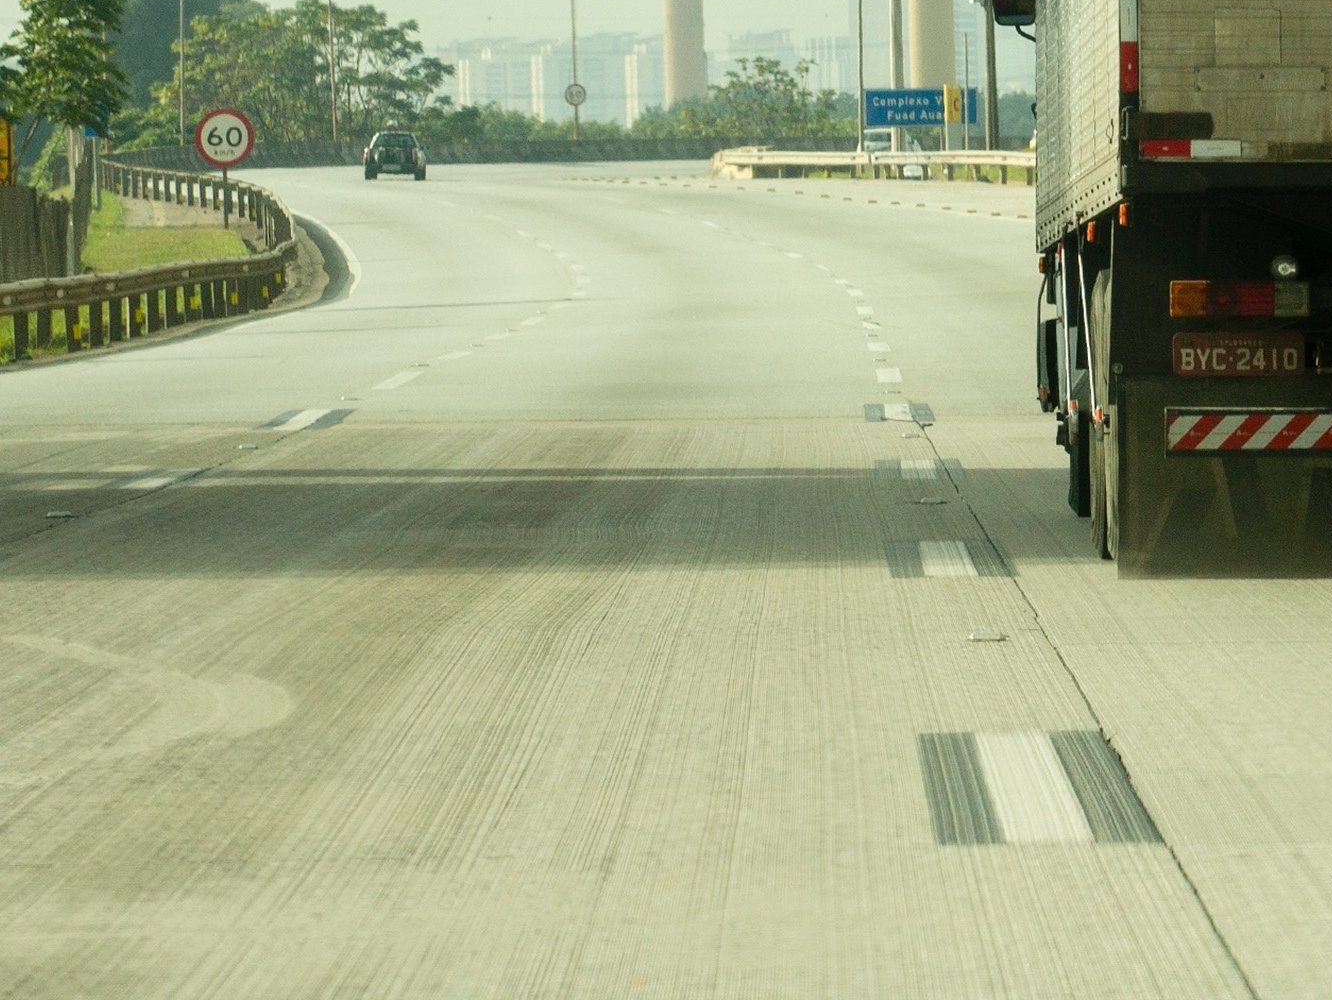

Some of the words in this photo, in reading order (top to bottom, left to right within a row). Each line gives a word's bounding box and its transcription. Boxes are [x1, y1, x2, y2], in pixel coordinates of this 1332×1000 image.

[872, 96, 929, 108] Complexo
[887, 111, 915, 120] Fuad
[920, 110, 945, 120] Aua
[207, 126, 243, 148] 60
